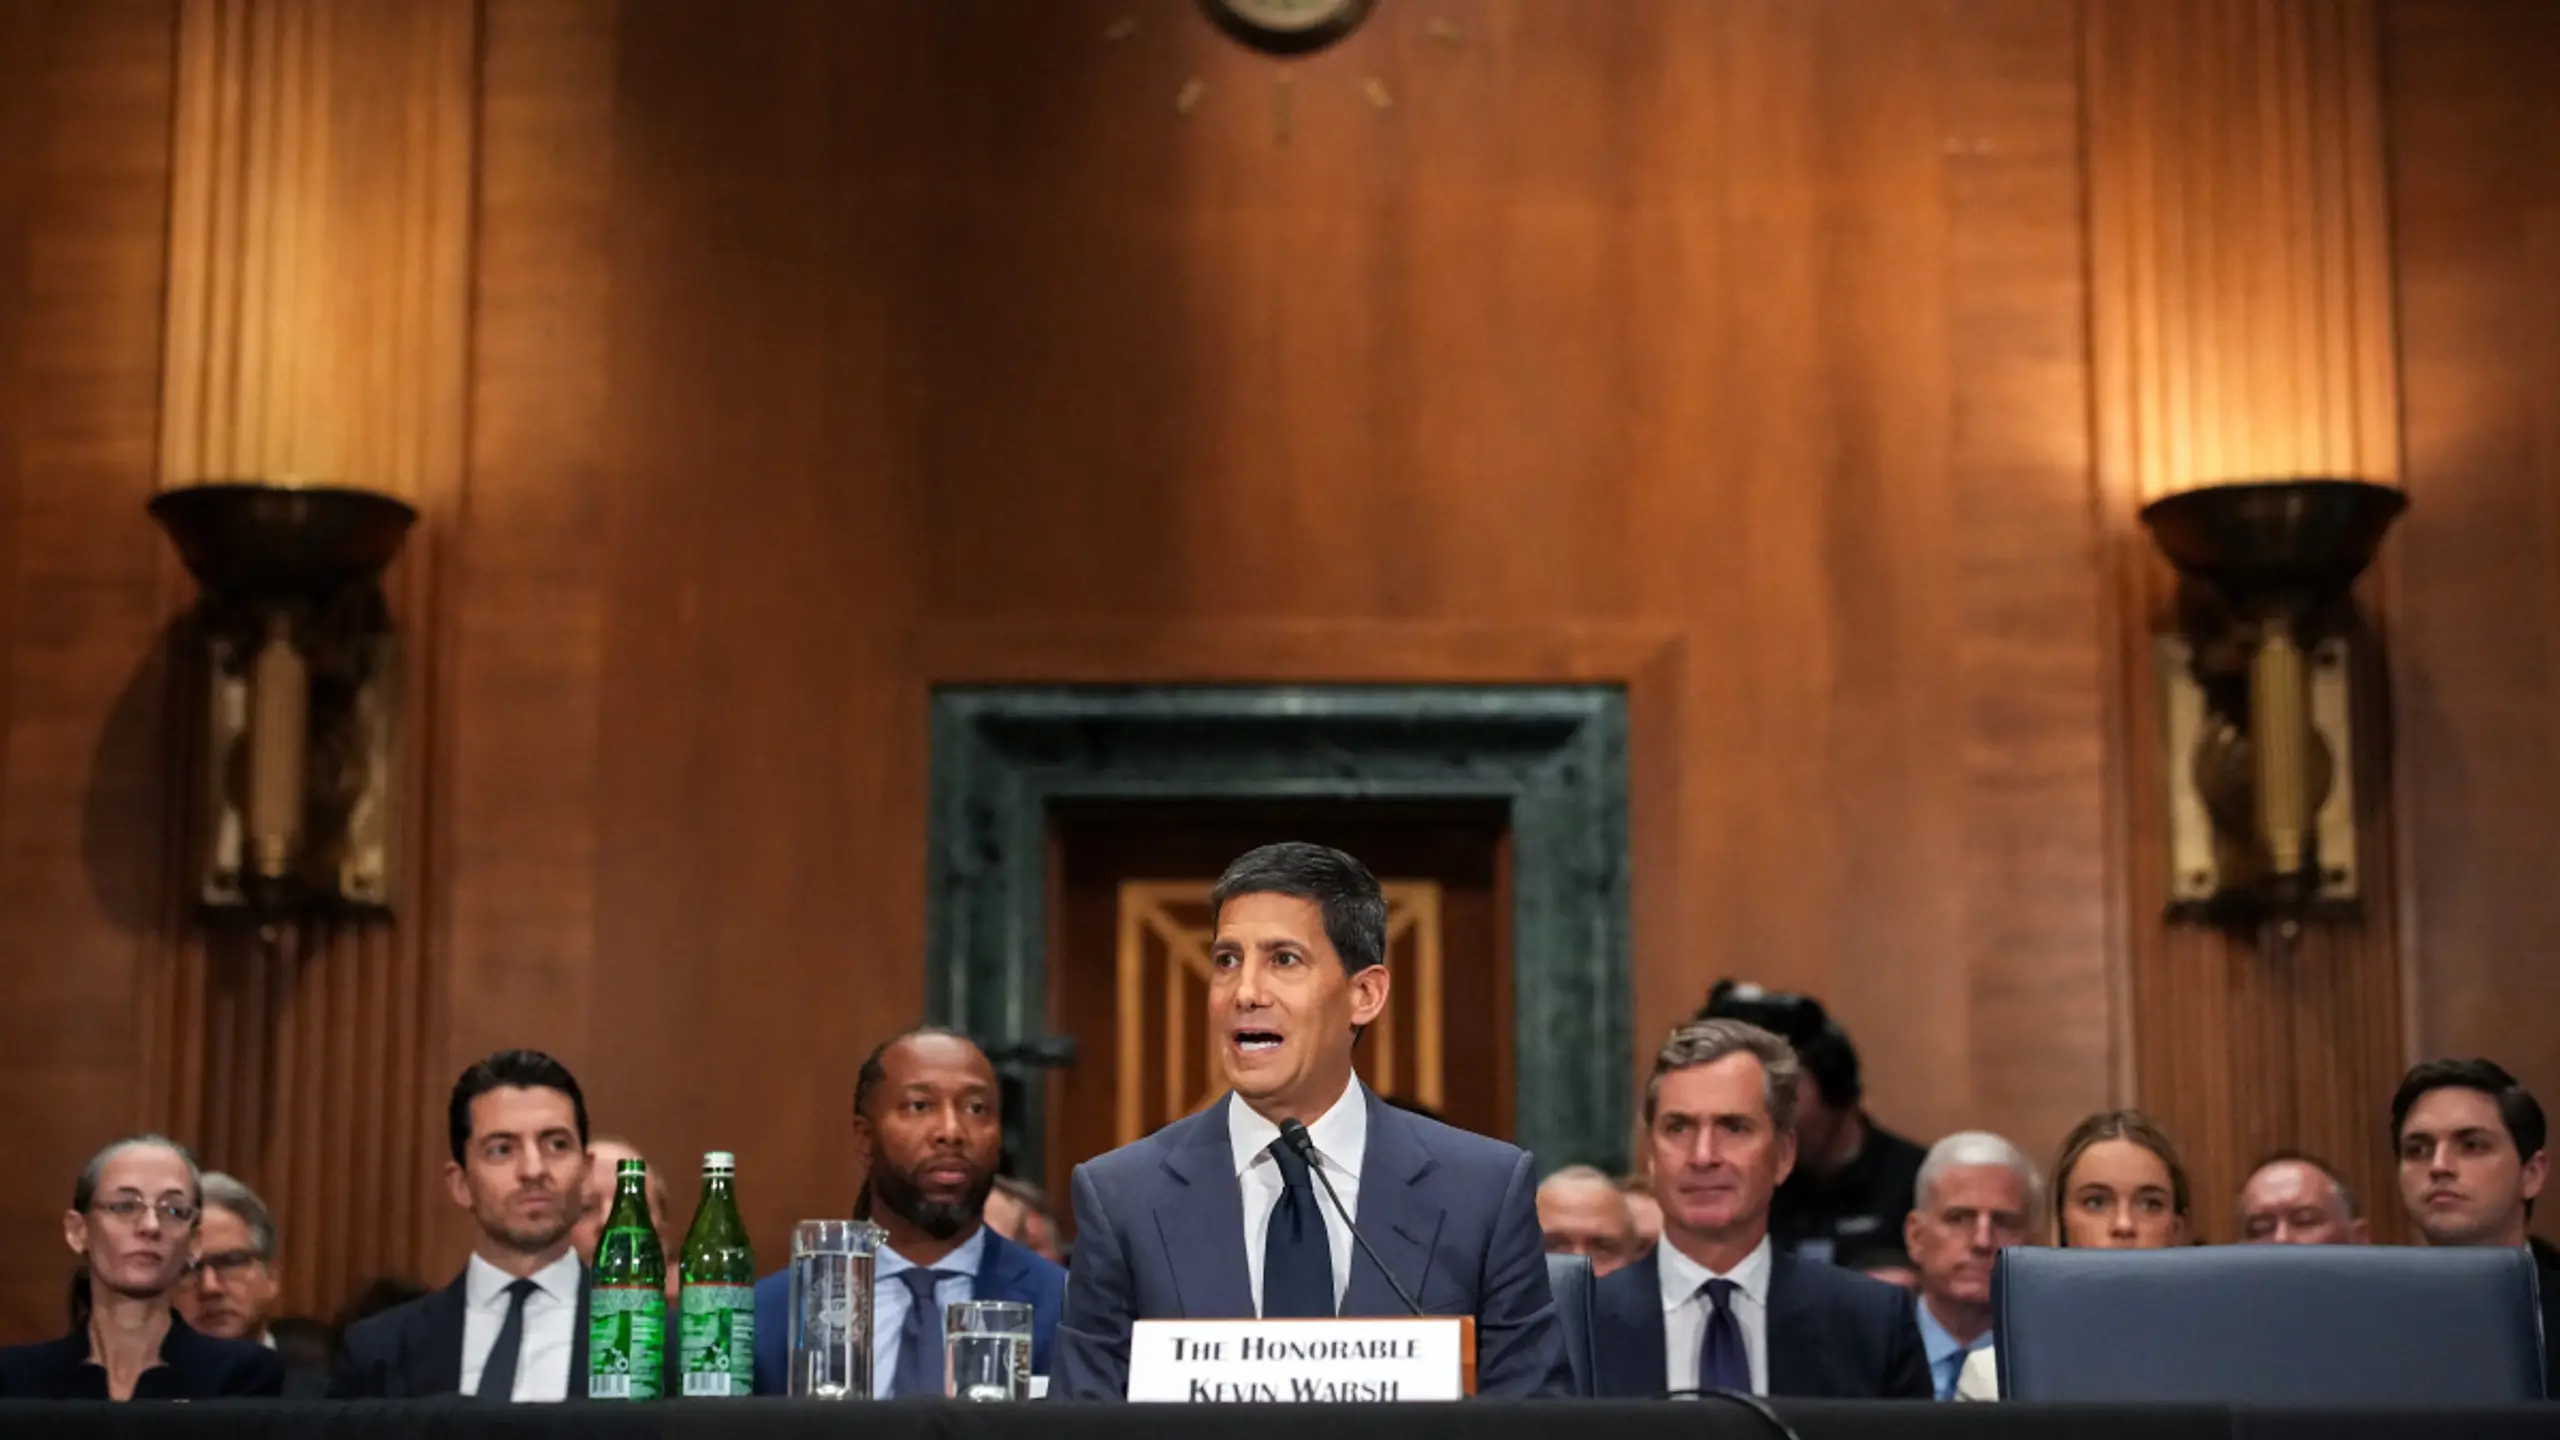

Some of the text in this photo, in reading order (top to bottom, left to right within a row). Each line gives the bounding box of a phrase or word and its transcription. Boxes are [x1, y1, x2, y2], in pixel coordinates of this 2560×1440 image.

[1170, 1336, 1421, 1361] THE HONORABLE
[1189, 1377, 1399, 1402] KEVIN WARSH
